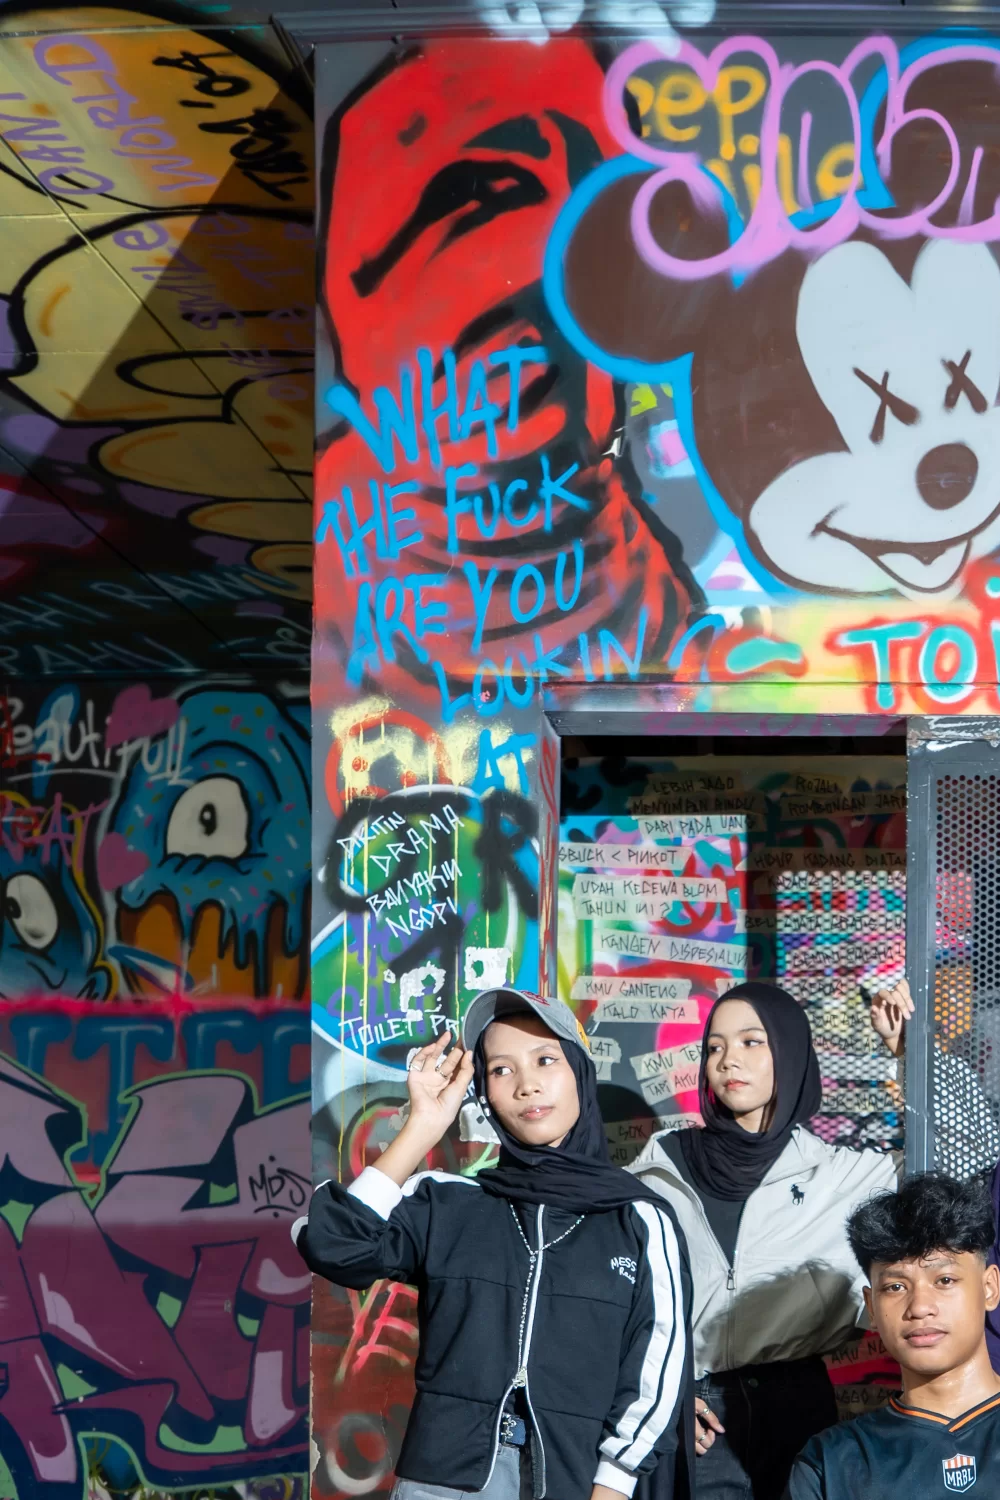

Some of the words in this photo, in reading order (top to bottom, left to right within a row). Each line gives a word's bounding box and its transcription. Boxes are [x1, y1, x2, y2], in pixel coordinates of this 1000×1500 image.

[33, 34, 218, 192] WORLD
[324, 346, 549, 473] WHAT
[316, 479, 424, 577] THE
[346, 574, 448, 687] ARE
[462, 539, 584, 654] YOU
[471, 728, 537, 797] AT
[370, 804, 465, 877] DRAMA
[644, 822, 674, 835] DARI
[680, 818, 713, 835] PADA
[580, 881, 615, 896] UDAH
[623, 880, 678, 896] KECEWA
[385, 896, 458, 937] NGOPI
[582, 901, 627, 916] TAHUN
[602, 934, 661, 955] KANGEN
[619, 981, 678, 999] GANTENG
[602, 1003, 639, 1019] KALO
[650, 1004, 686, 1020] KAYA
[339, 1014, 416, 1049] TOILET
[610, 1256, 637, 1272] MESS
[946, 1468, 974, 1487] MRBL
